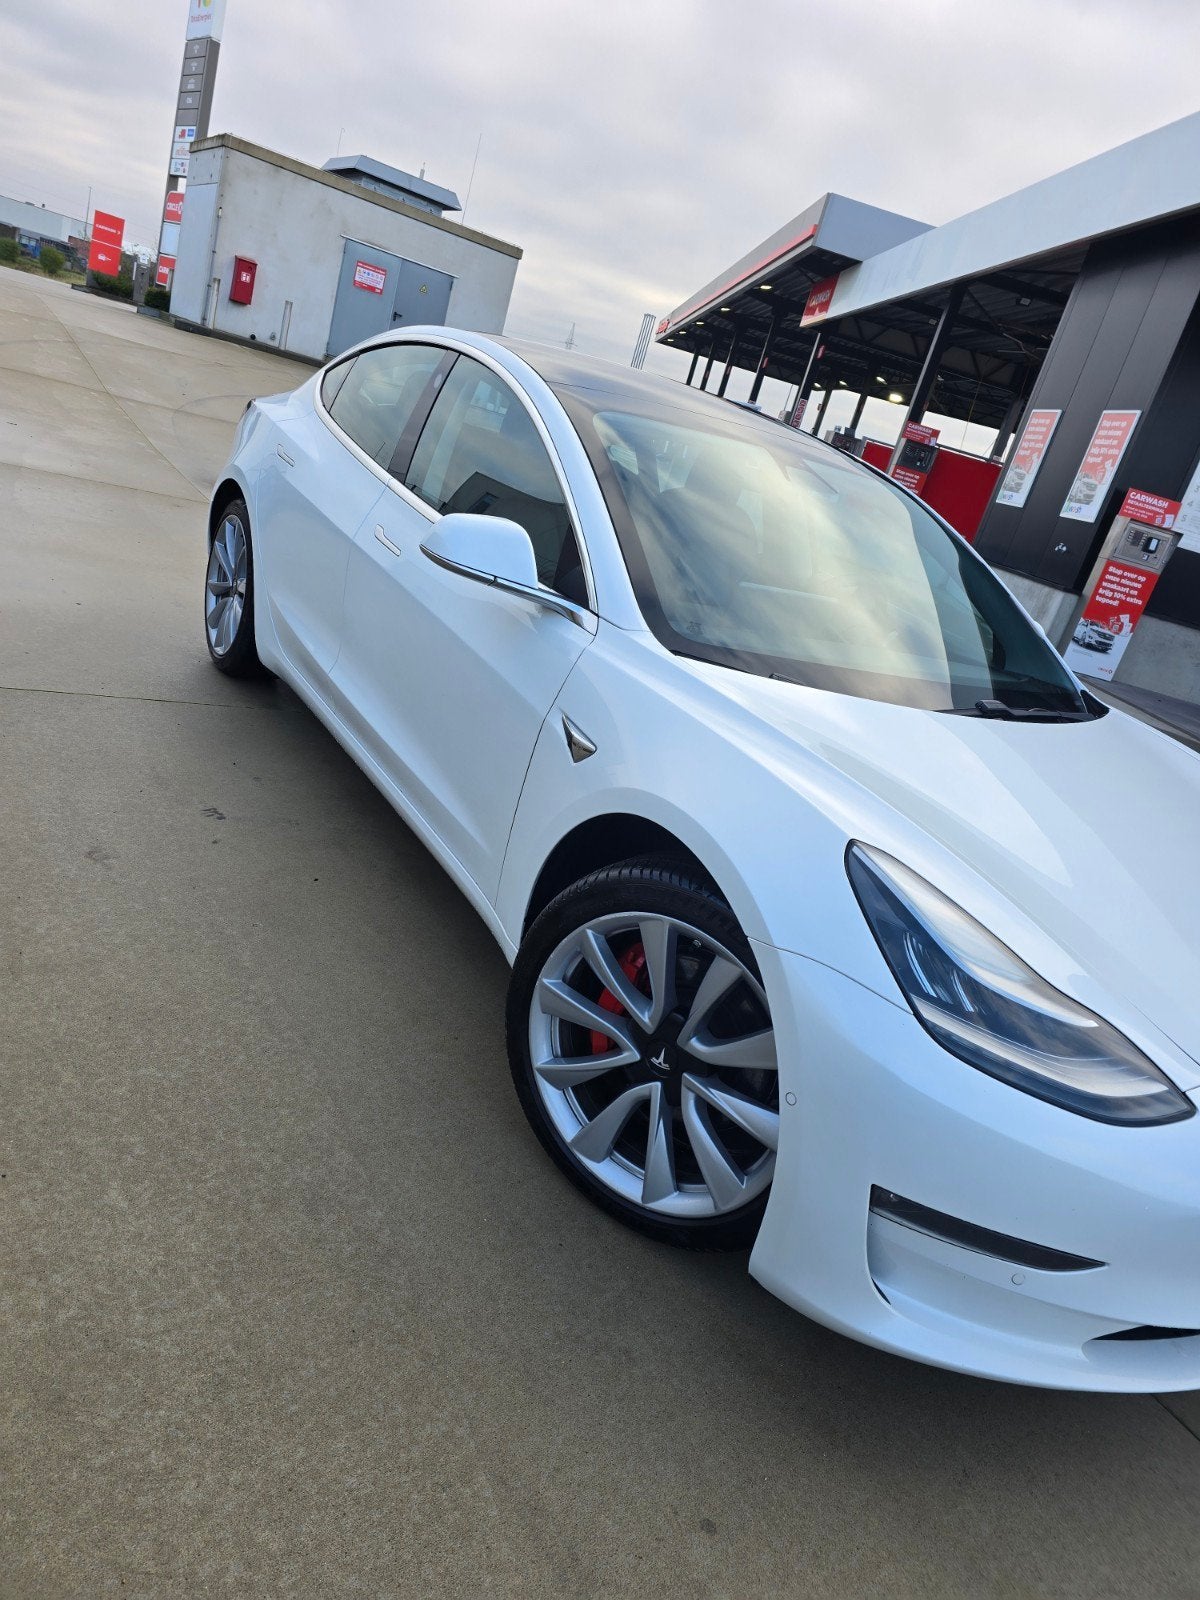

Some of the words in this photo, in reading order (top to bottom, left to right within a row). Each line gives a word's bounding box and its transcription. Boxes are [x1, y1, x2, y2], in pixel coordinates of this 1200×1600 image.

[809, 289, 832, 307] CARWASH
[1130, 492, 1169, 508] CARWASH
[1108, 566, 1123, 575] Stap
[1102, 582, 1129, 593] waskaart
[1121, 579, 1142, 588] nieuwe
[1099, 588, 1113, 597] krijg
[1114, 592, 1126, 600] 10%
[1126, 596, 1142, 605] extra
